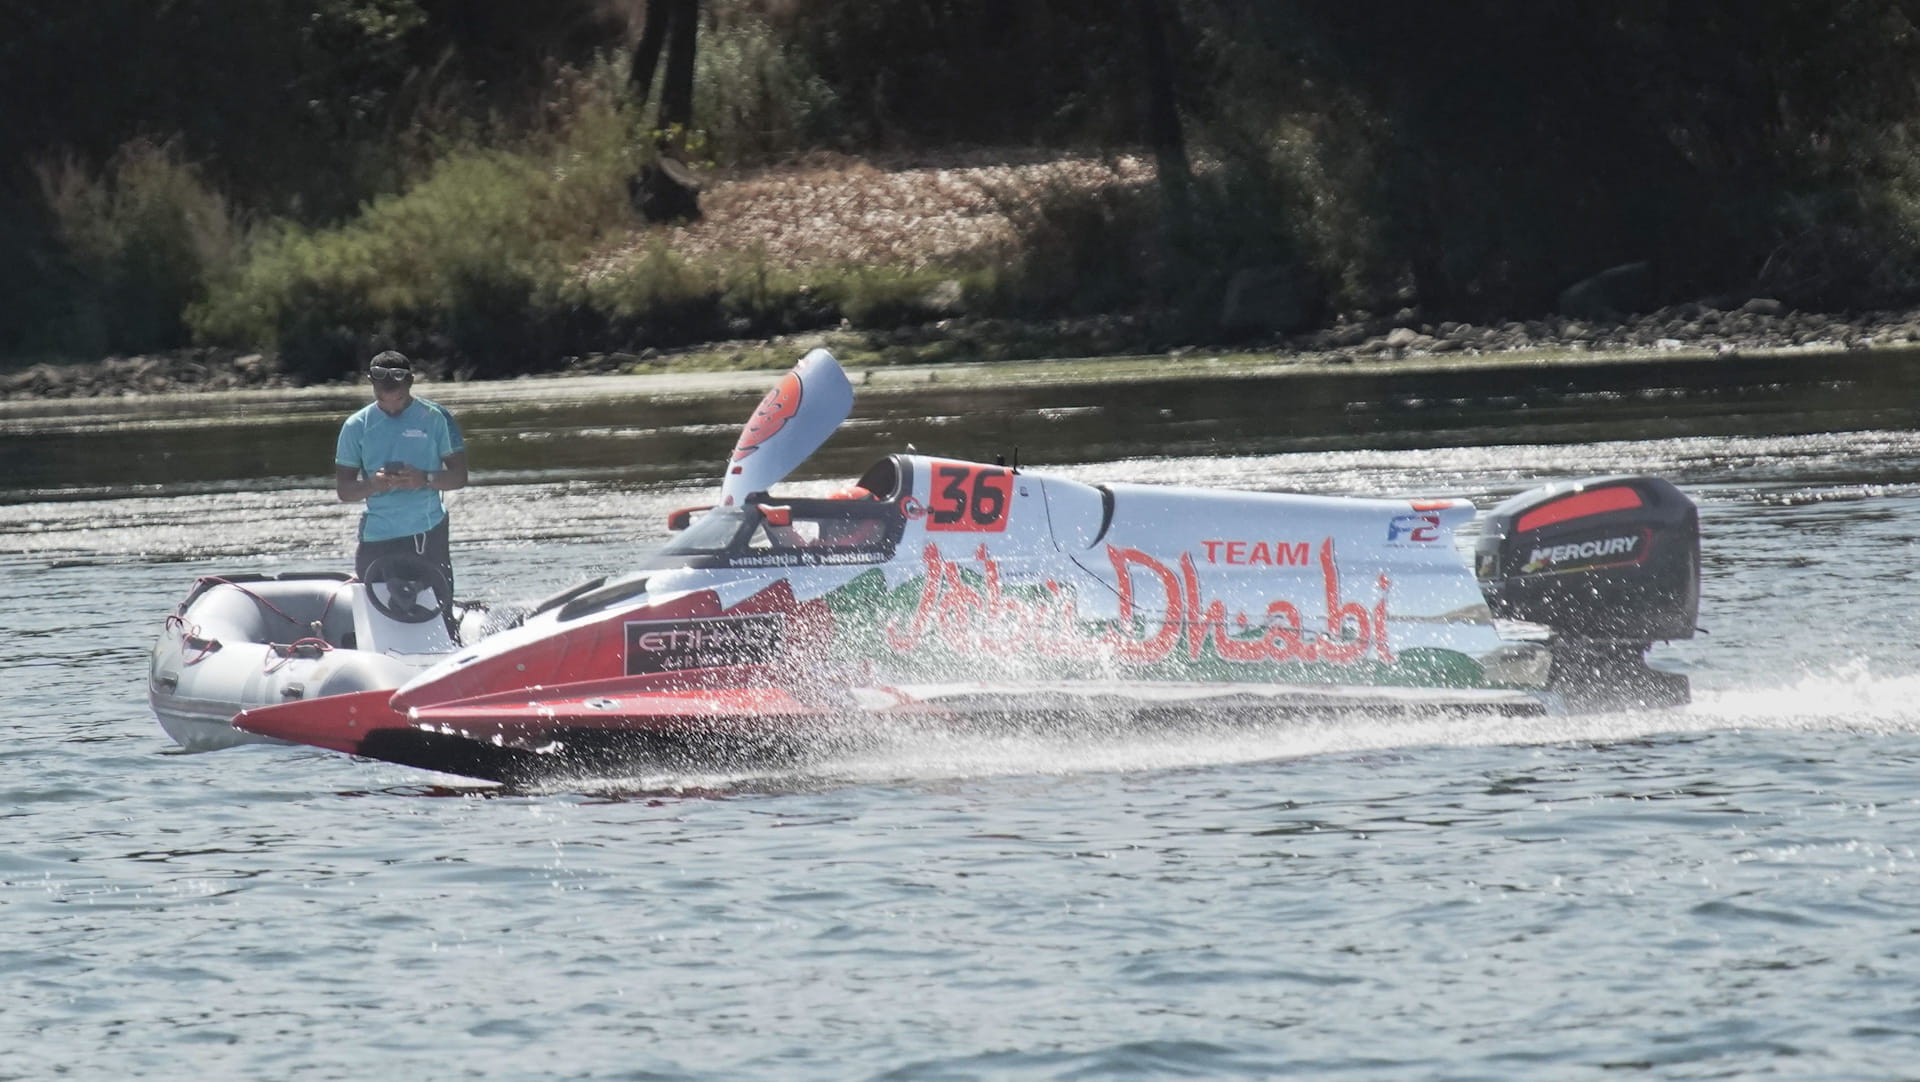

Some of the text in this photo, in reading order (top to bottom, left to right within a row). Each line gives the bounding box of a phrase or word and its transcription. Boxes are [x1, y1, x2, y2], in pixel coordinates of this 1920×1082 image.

[933, 466, 1005, 525] 36
[1388, 515, 1440, 541] F2
[1201, 541, 1310, 566] TEAM
[1528, 536, 1638, 563] MERCURY
[1106, 537, 1397, 663] Dhabi
